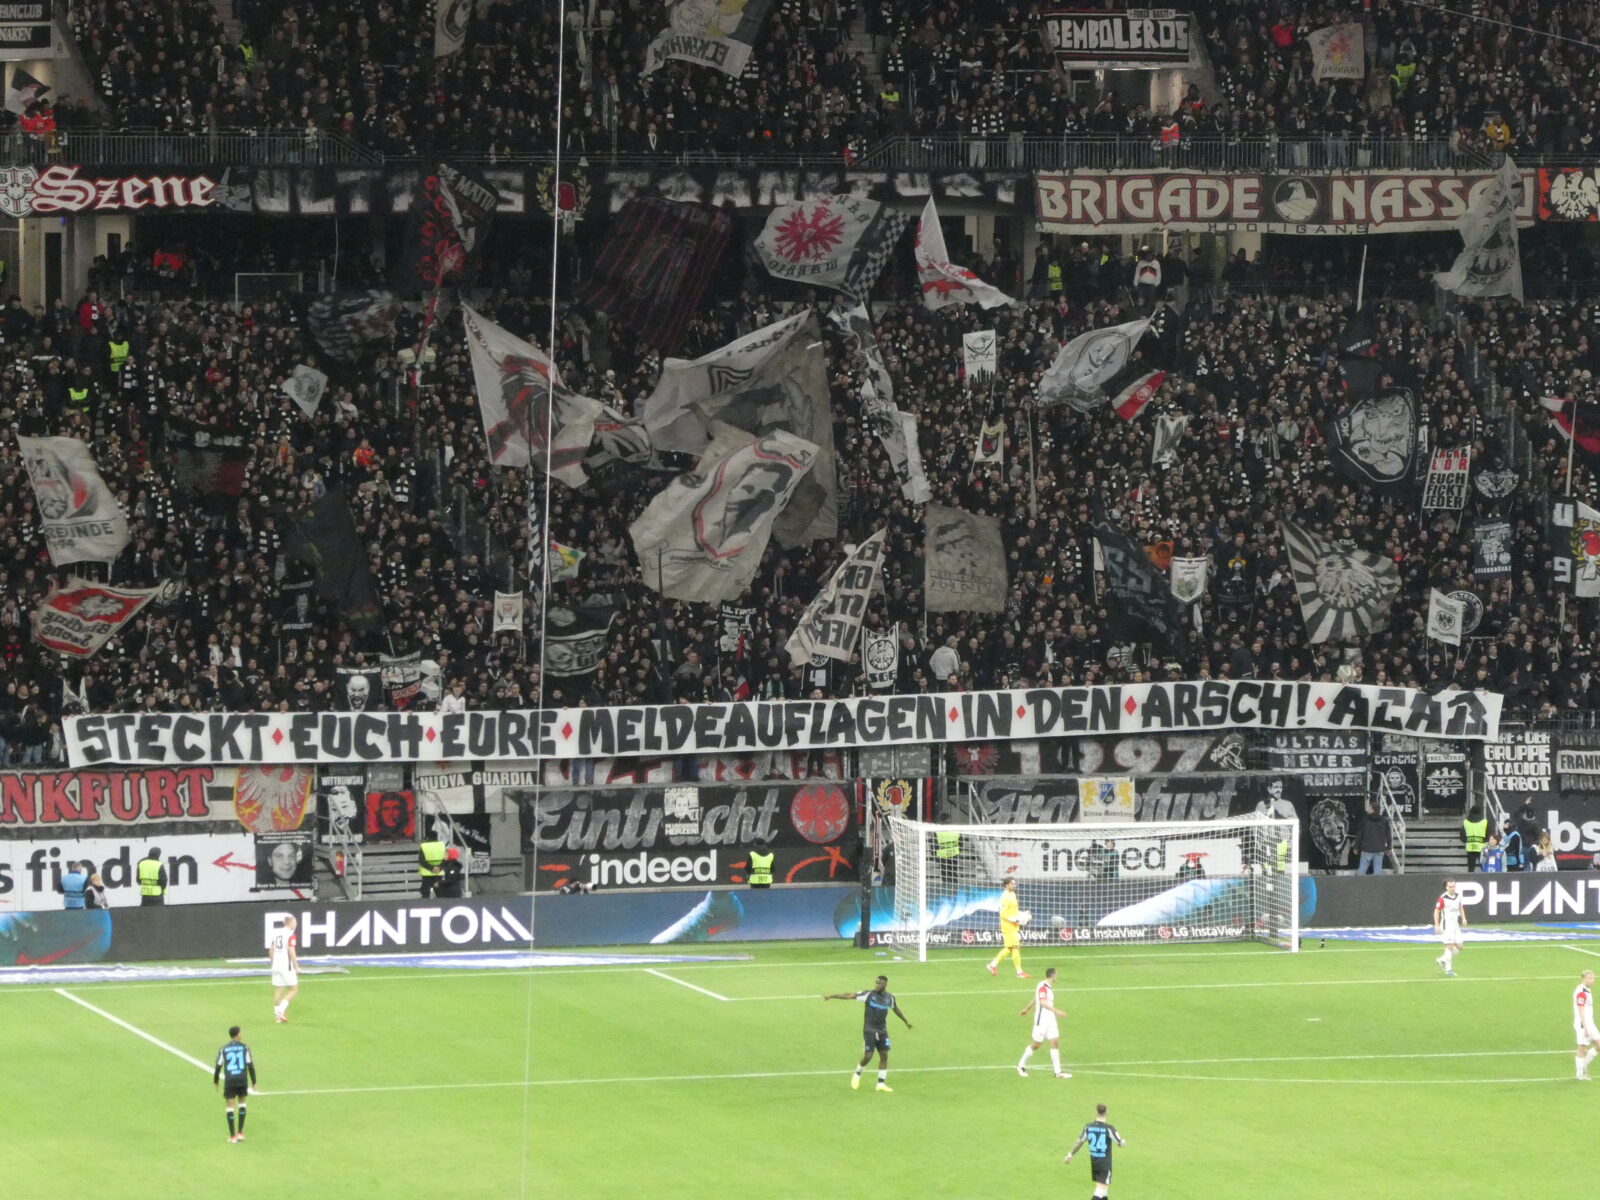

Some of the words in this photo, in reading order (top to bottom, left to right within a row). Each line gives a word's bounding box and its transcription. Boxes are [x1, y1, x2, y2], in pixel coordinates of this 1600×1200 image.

[1047, 18, 1188, 48] BEMBOLEROS
[32, 166, 217, 212] Szene
[1036, 175, 1263, 227] BRIGADE
[1207, 222, 1367, 235] HOOLIGANS
[1426, 484, 1465, 496] FICKT
[1424, 495, 1463, 508] JEDER
[869, 670, 897, 682] SGE
[77, 714, 271, 763] STECKT
[290, 711, 424, 760] EUCH
[440, 710, 559, 758] EURE
[579, 696, 949, 755] MELDEAUFLAGEN
[962, 693, 1012, 740] IN
[1026, 686, 1121, 734] DEN
[1141, 681, 1310, 729] ARSCH!
[1276, 735, 1358, 749] ULTRAS
[1374, 755, 1417, 765] EXTREME
[1484, 745, 1550, 761] GRUPPE
[1284, 754, 1353, 769] NEVER
[1485, 762, 1551, 776] STADION
[419, 773, 465, 790] NUOVA
[472, 771, 534, 786] GUARDIA
[1486, 776, 1551, 792] VERBOT
[0, 767, 216, 824] NKFURT
[530, 787, 781, 851] Eintrcht
[588, 849, 719, 887] indeed
[264, 906, 535, 949] PHANTOM
[1074, 928, 1091, 939] LG
[1093, 926, 1147, 939] InstaView
[1172, 926, 1189, 937] LG
[1190, 924, 1246, 937] InstaView
[226, 1051, 244, 1070] 21
[1088, 1132, 1107, 1152] 24
